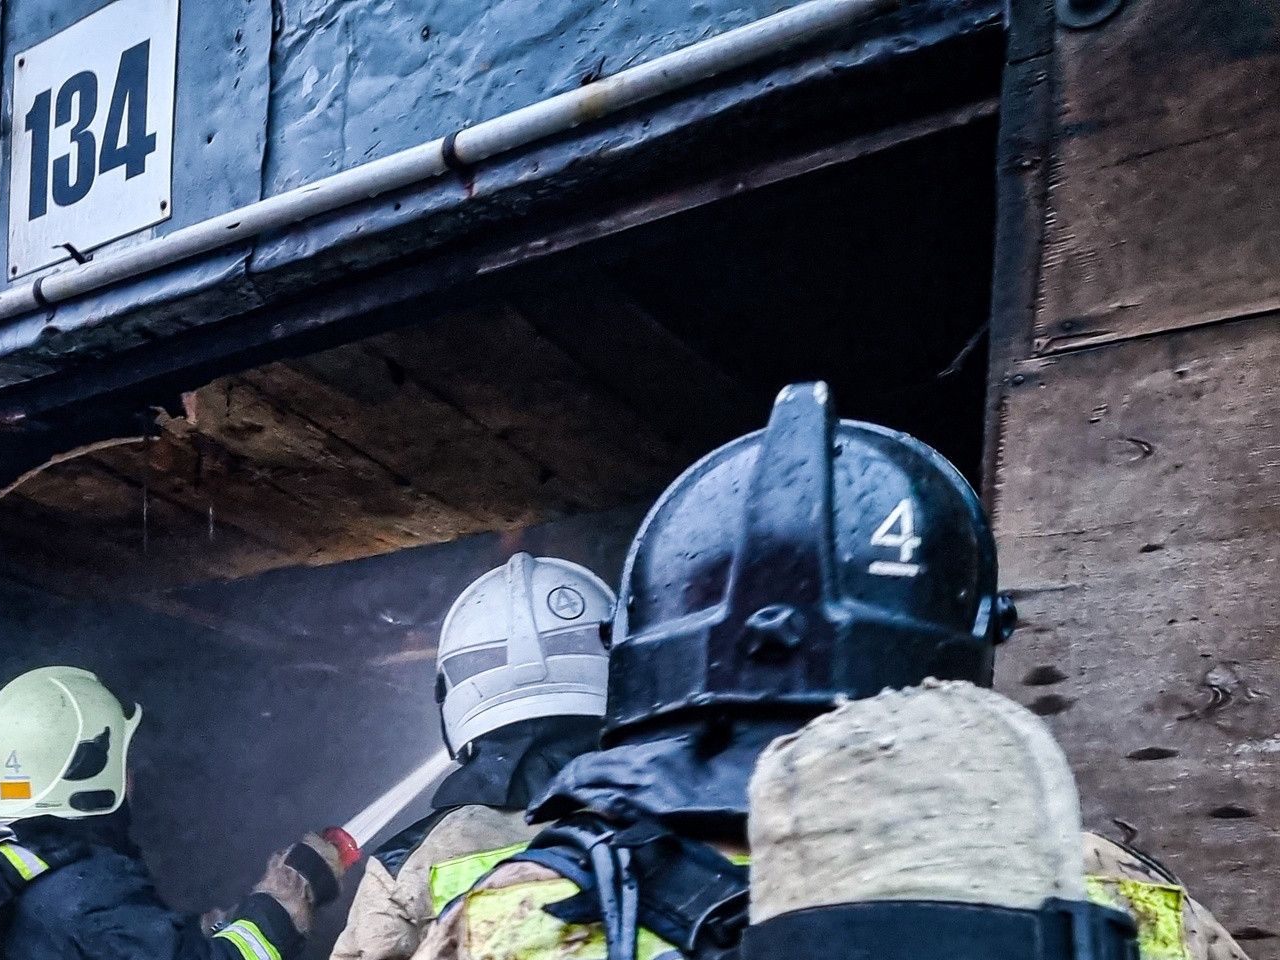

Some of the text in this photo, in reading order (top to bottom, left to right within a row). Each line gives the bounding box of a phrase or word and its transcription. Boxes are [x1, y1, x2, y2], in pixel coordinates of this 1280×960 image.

[25, 37, 157, 221] 134
[870, 498, 922, 562] 4
[4, 749, 22, 773] 4
